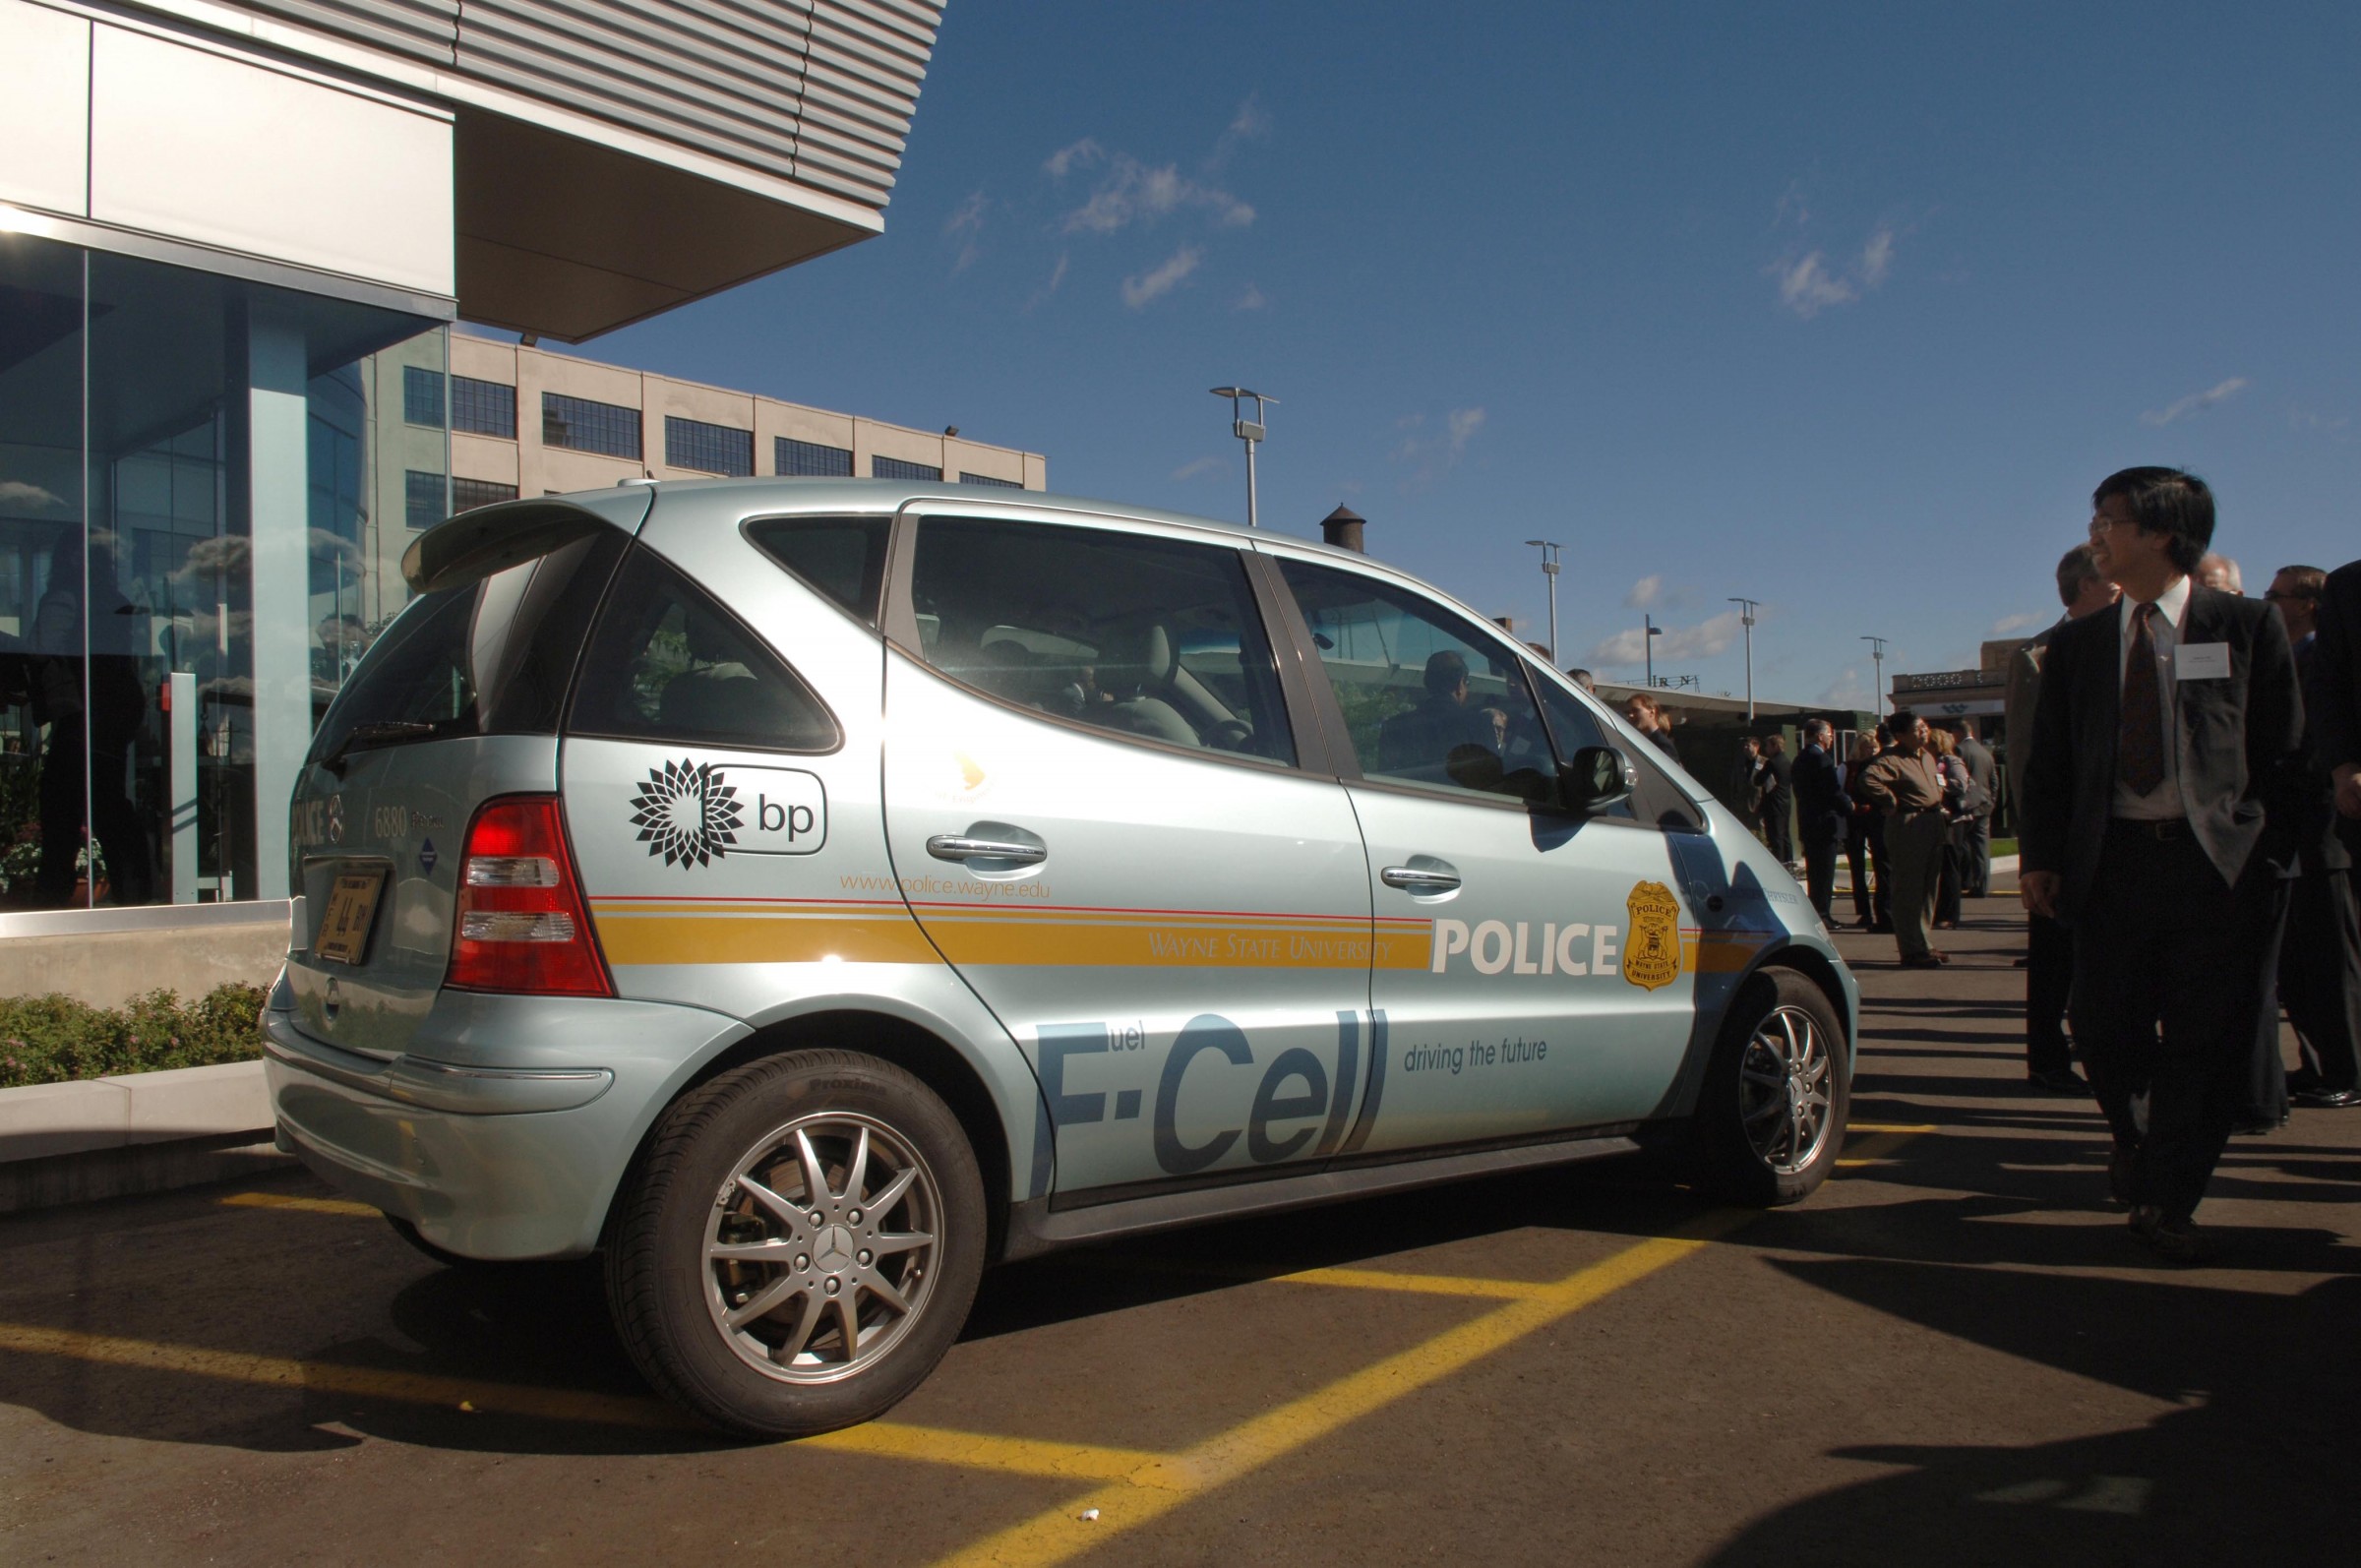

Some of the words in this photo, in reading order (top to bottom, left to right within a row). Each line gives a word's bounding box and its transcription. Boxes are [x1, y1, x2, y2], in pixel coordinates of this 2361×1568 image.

[375, 805, 407, 838] 6880
[759, 793, 815, 843] bp
[839, 874, 1051, 901] www.police.wayne.edu
[1636, 904, 1671, 917] POLICE
[1431, 918, 1617, 976] POLICE
[1631, 970, 1671, 981] UNIVERSITY
[1635, 960, 1652, 970] WAYNE
[1654, 960, 1669, 970] STATE
[1404, 1045, 1464, 1075] driving
[1470, 1040, 1495, 1066] the
[1501, 1037, 1547, 1063] future
